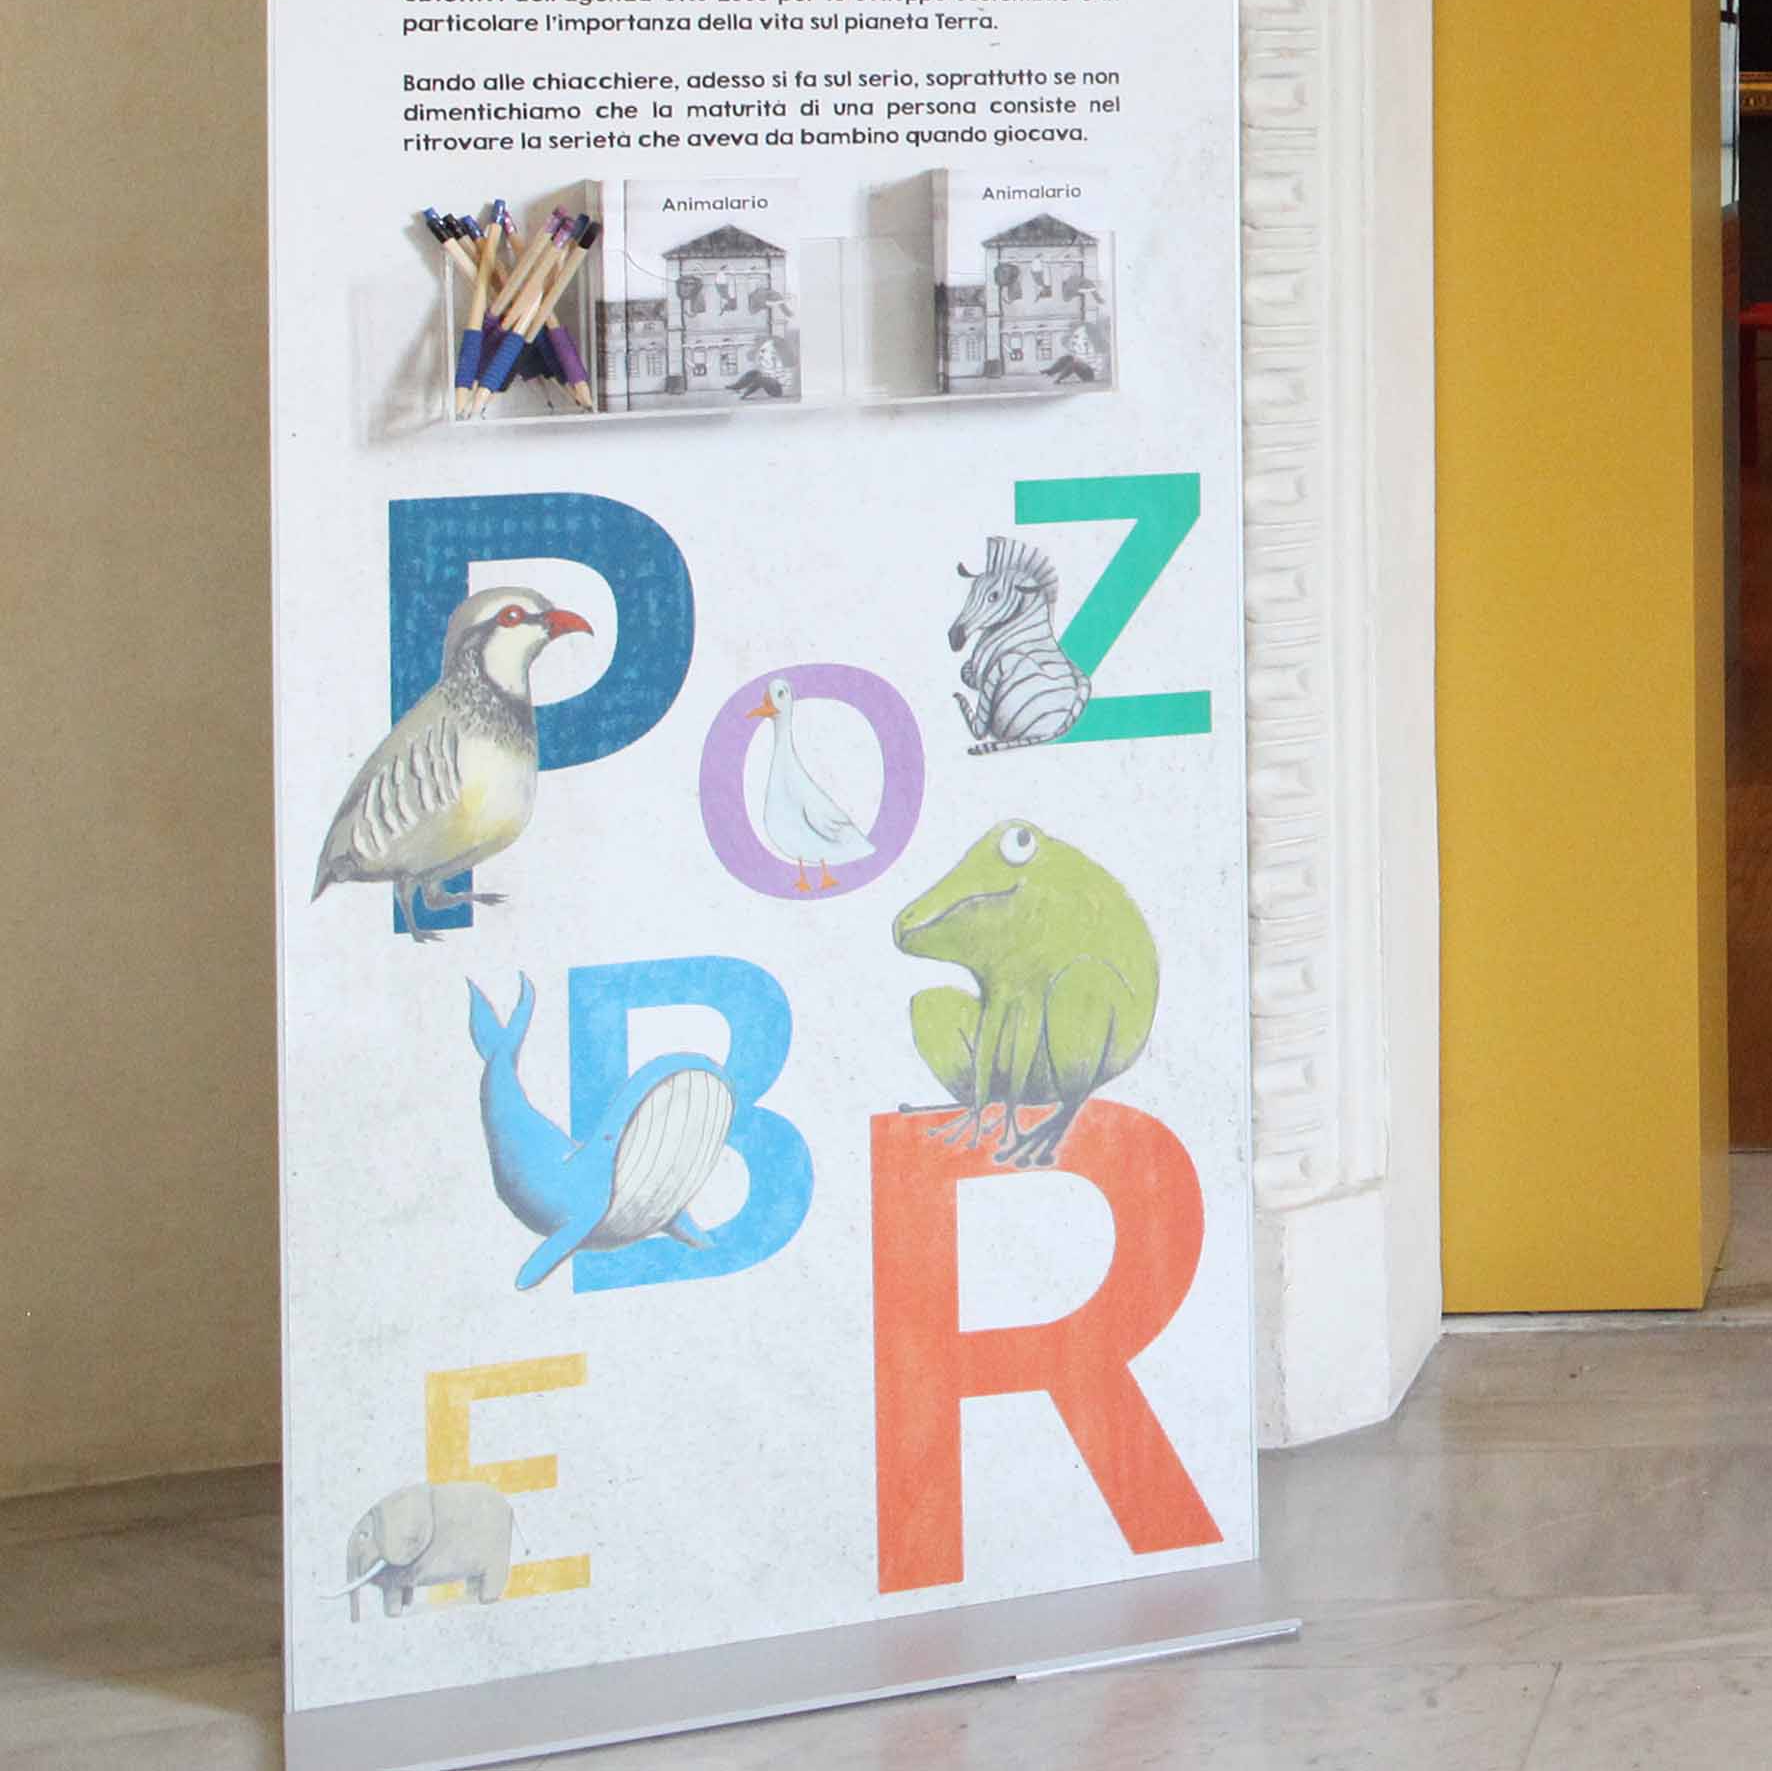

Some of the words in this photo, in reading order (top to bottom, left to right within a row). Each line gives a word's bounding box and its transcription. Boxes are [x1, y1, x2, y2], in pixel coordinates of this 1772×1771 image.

[403, 73, 477, 93] Bando
[482, 72, 526, 92] alle
[531, 71, 680, 93] chiacchiere,
[686, 70, 766, 90] adesso
[771, 69, 788, 89] si
[794, 69, 818, 89] fa
[823, 70, 853, 88] sul
[857, 68, 920, 90] serio,
[925, 68, 1048, 91] soprattutto
[1053, 71, 1077, 86] se
[1082, 71, 1120, 85] non
[661, 195, 769, 212] Animalario
[981, 184, 1082, 201] Animalario
[387, 492, 696, 936] P
[1013, 471, 1212, 747] Z
[698, 661, 925, 901] O
[567, 955, 815, 1294] B
[868, 1098, 1224, 1595] R
[425, 1352, 592, 1606] E
